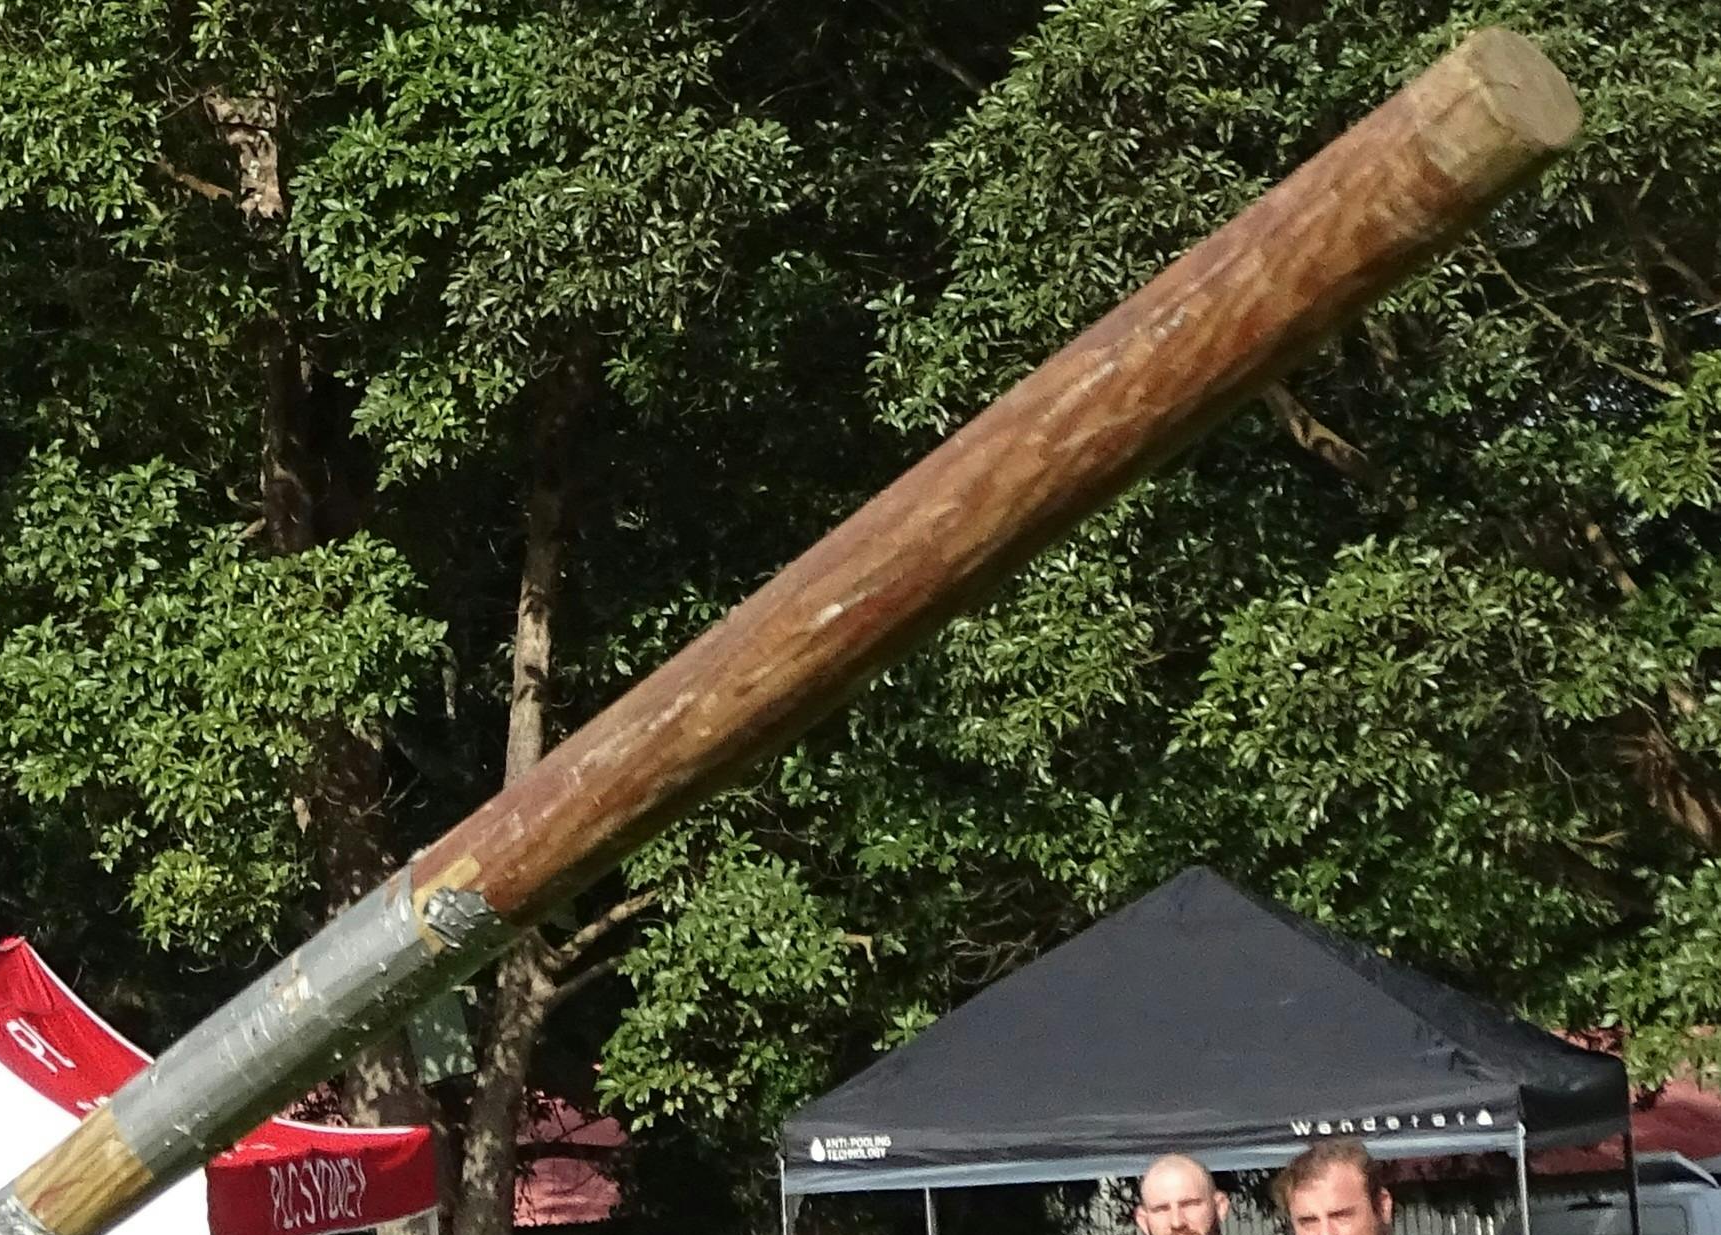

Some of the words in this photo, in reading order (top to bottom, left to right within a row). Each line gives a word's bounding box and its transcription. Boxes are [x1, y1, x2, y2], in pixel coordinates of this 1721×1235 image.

[825, 1134, 892, 1149] ANTI-POOLING
[826, 1147, 887, 1161] TECHNOLOGY
[300, 1157, 367, 1225] SYDNEY
